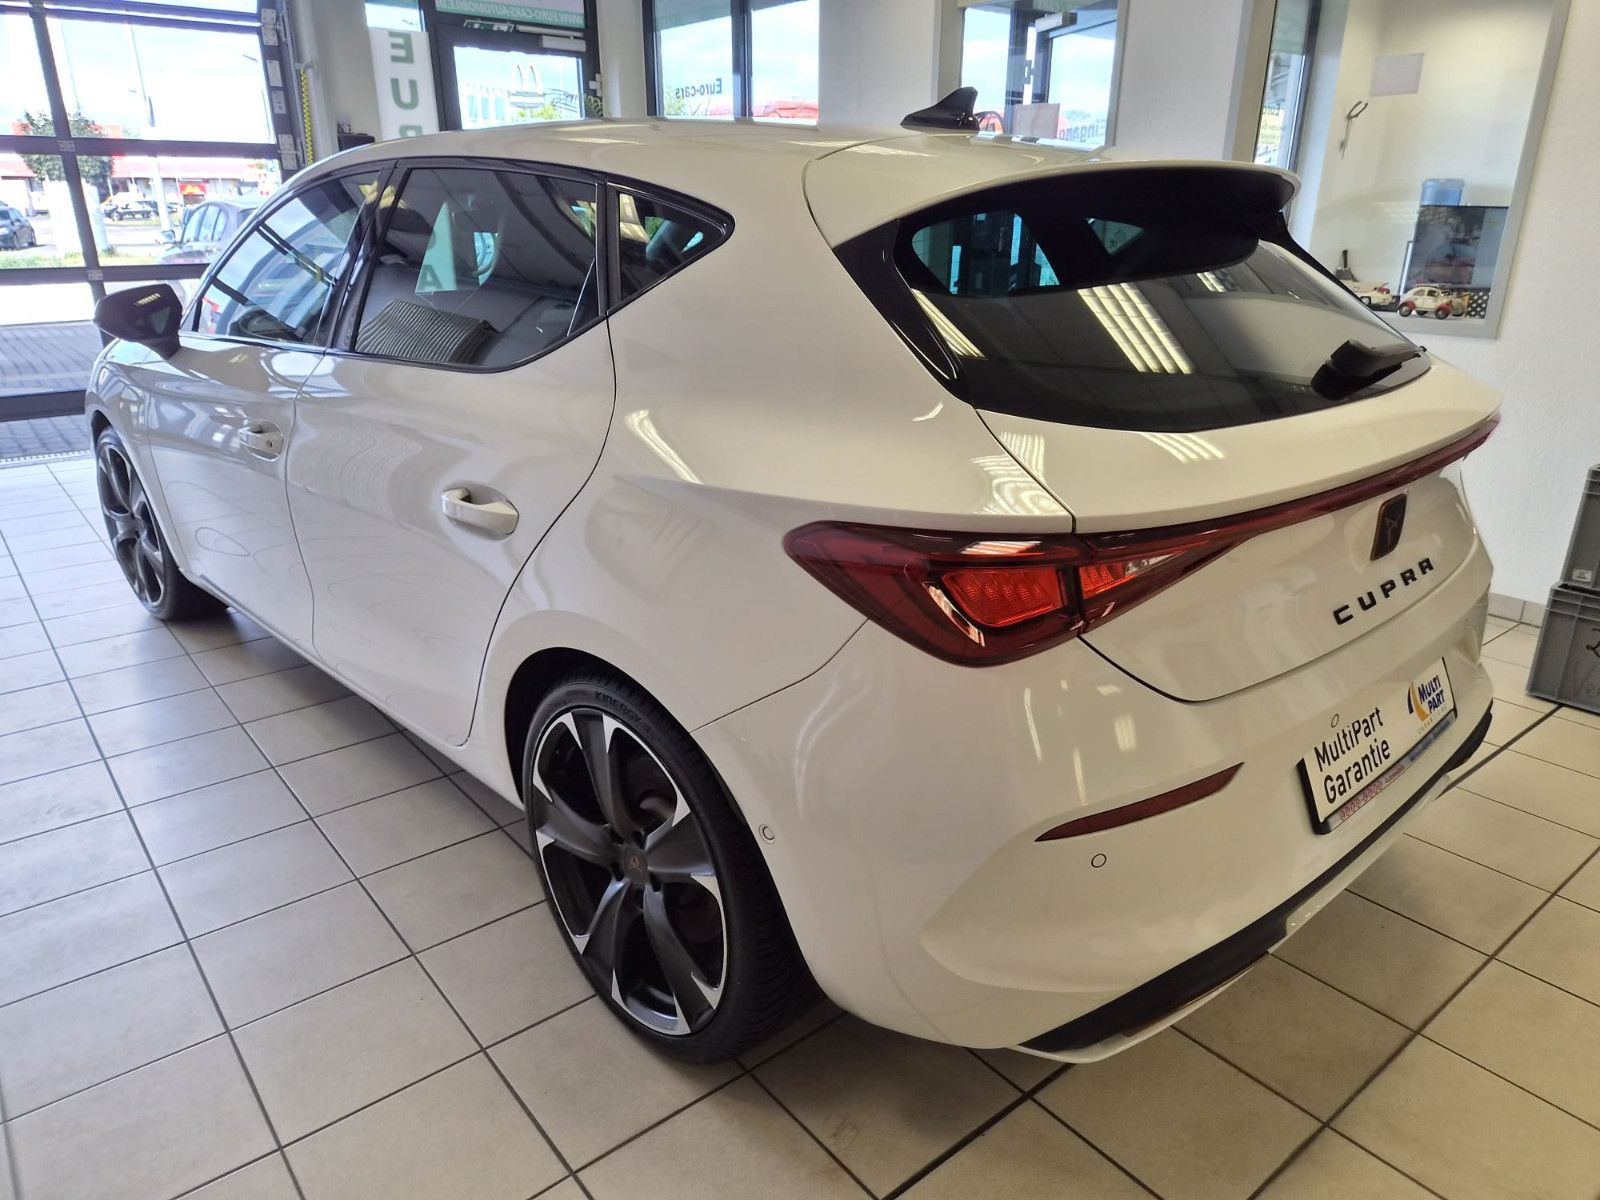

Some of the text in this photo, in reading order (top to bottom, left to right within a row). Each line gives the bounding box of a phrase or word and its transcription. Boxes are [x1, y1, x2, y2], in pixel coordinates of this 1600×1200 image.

[1332, 557, 1434, 625] CUPRA
[1417, 674, 1441, 704] MULTI
[1427, 689, 1445, 715] PART
[1313, 706, 1384, 772] MultiPart
[1323, 737, 1391, 804] Garantie
